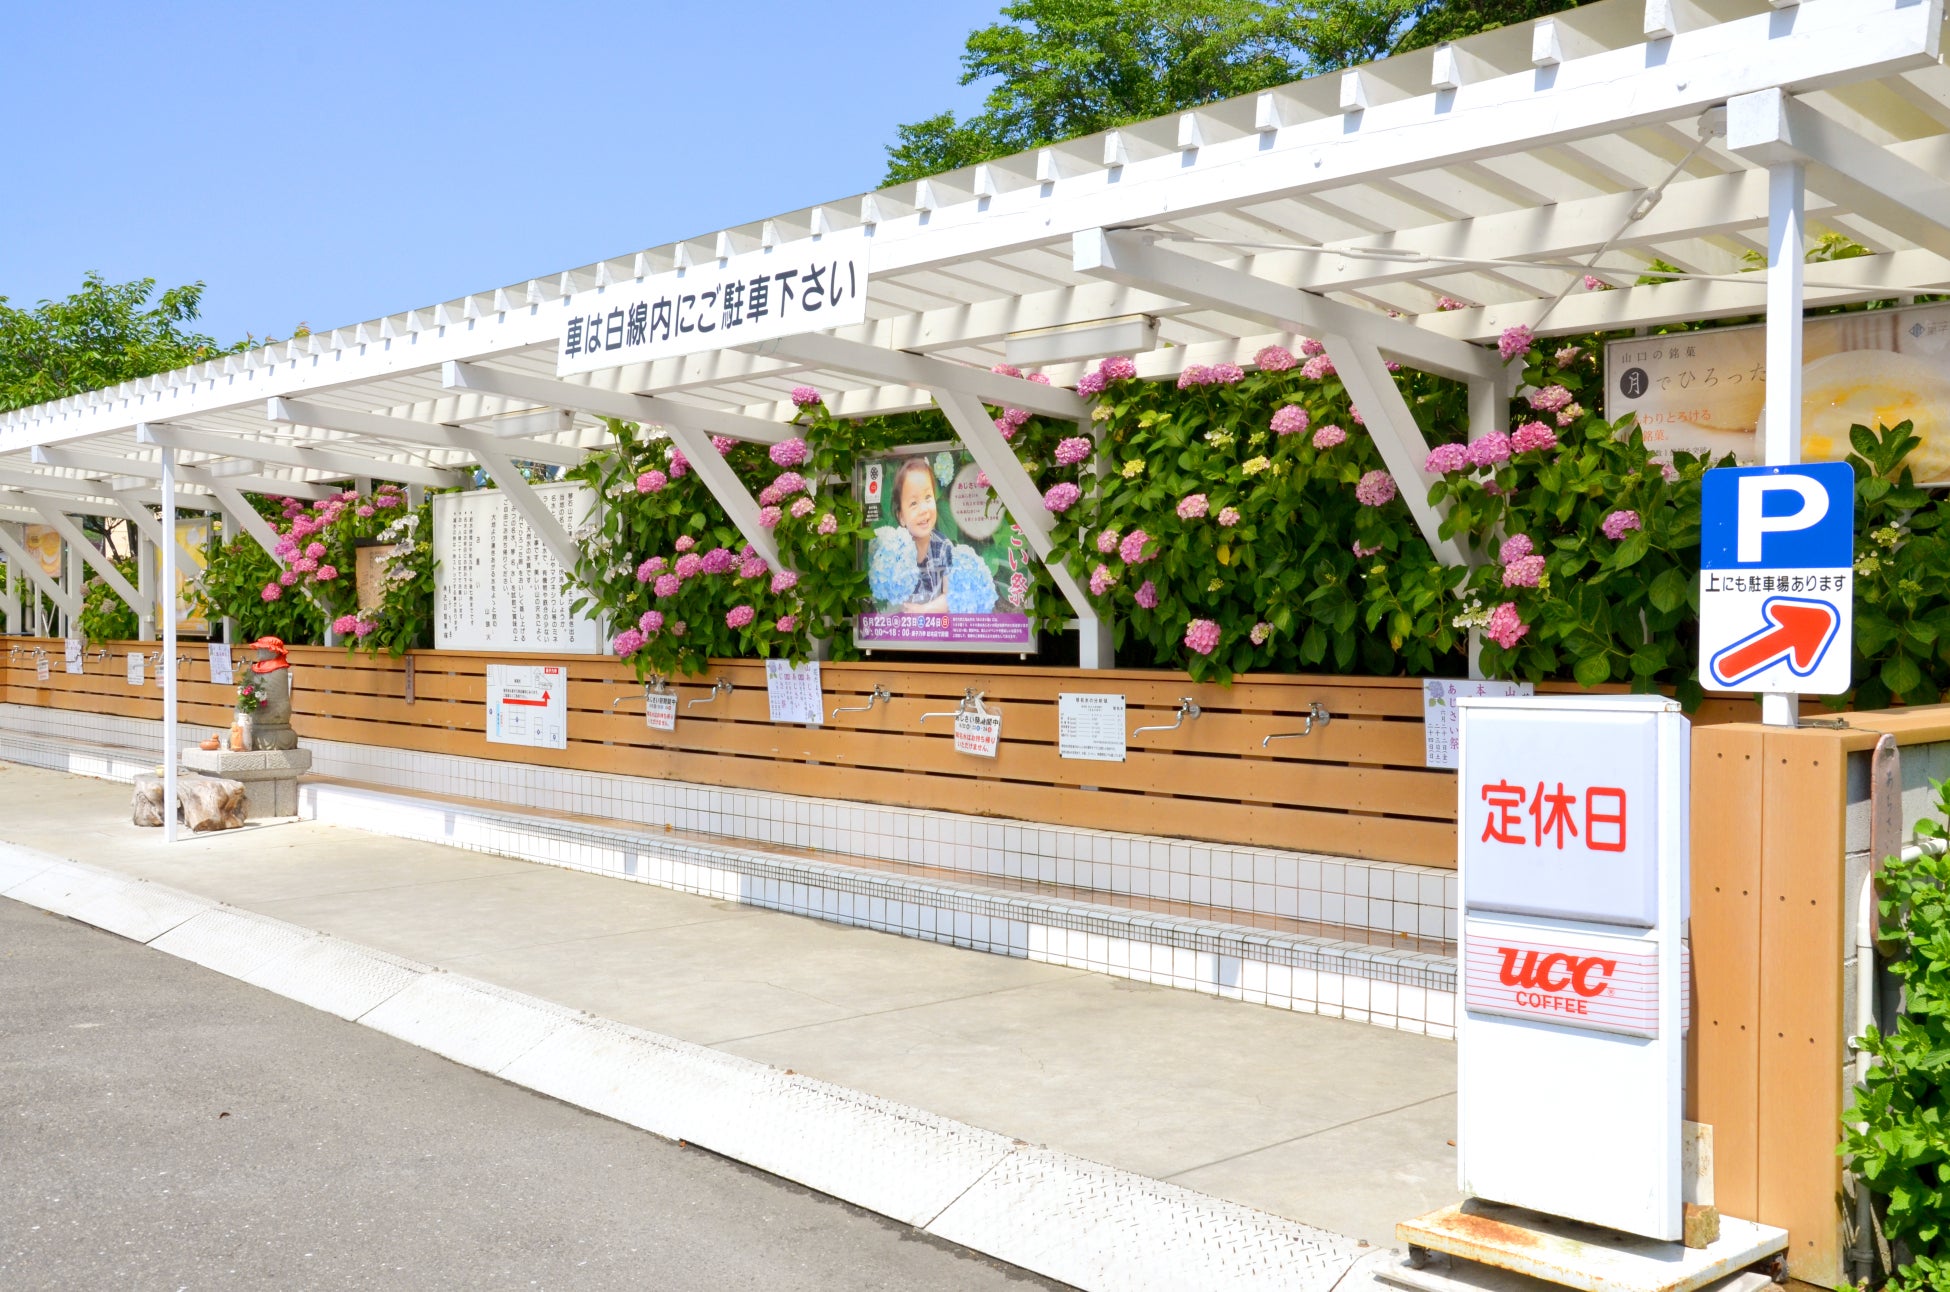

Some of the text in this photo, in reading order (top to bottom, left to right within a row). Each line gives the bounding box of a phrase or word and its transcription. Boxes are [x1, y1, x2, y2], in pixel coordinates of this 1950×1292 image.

[564, 260, 857, 359] 車は白線内にご駐車下さい
[1621, 346, 1697, 364] 山口の銘菓
[1626, 362, 1767, 397] 月でひろった
[1632, 409, 1712, 426] んわりとろける
[1737, 473, 1830, 563] P
[1705, 572, 1847, 594] 上にも駐車場あります
[1476, 683, 1486, 697] 本
[1447, 683, 1459, 750] あじさい祭
[1481, 778, 1627, 853] 定休日
[1515, 991, 1588, 1016] COFFEE
